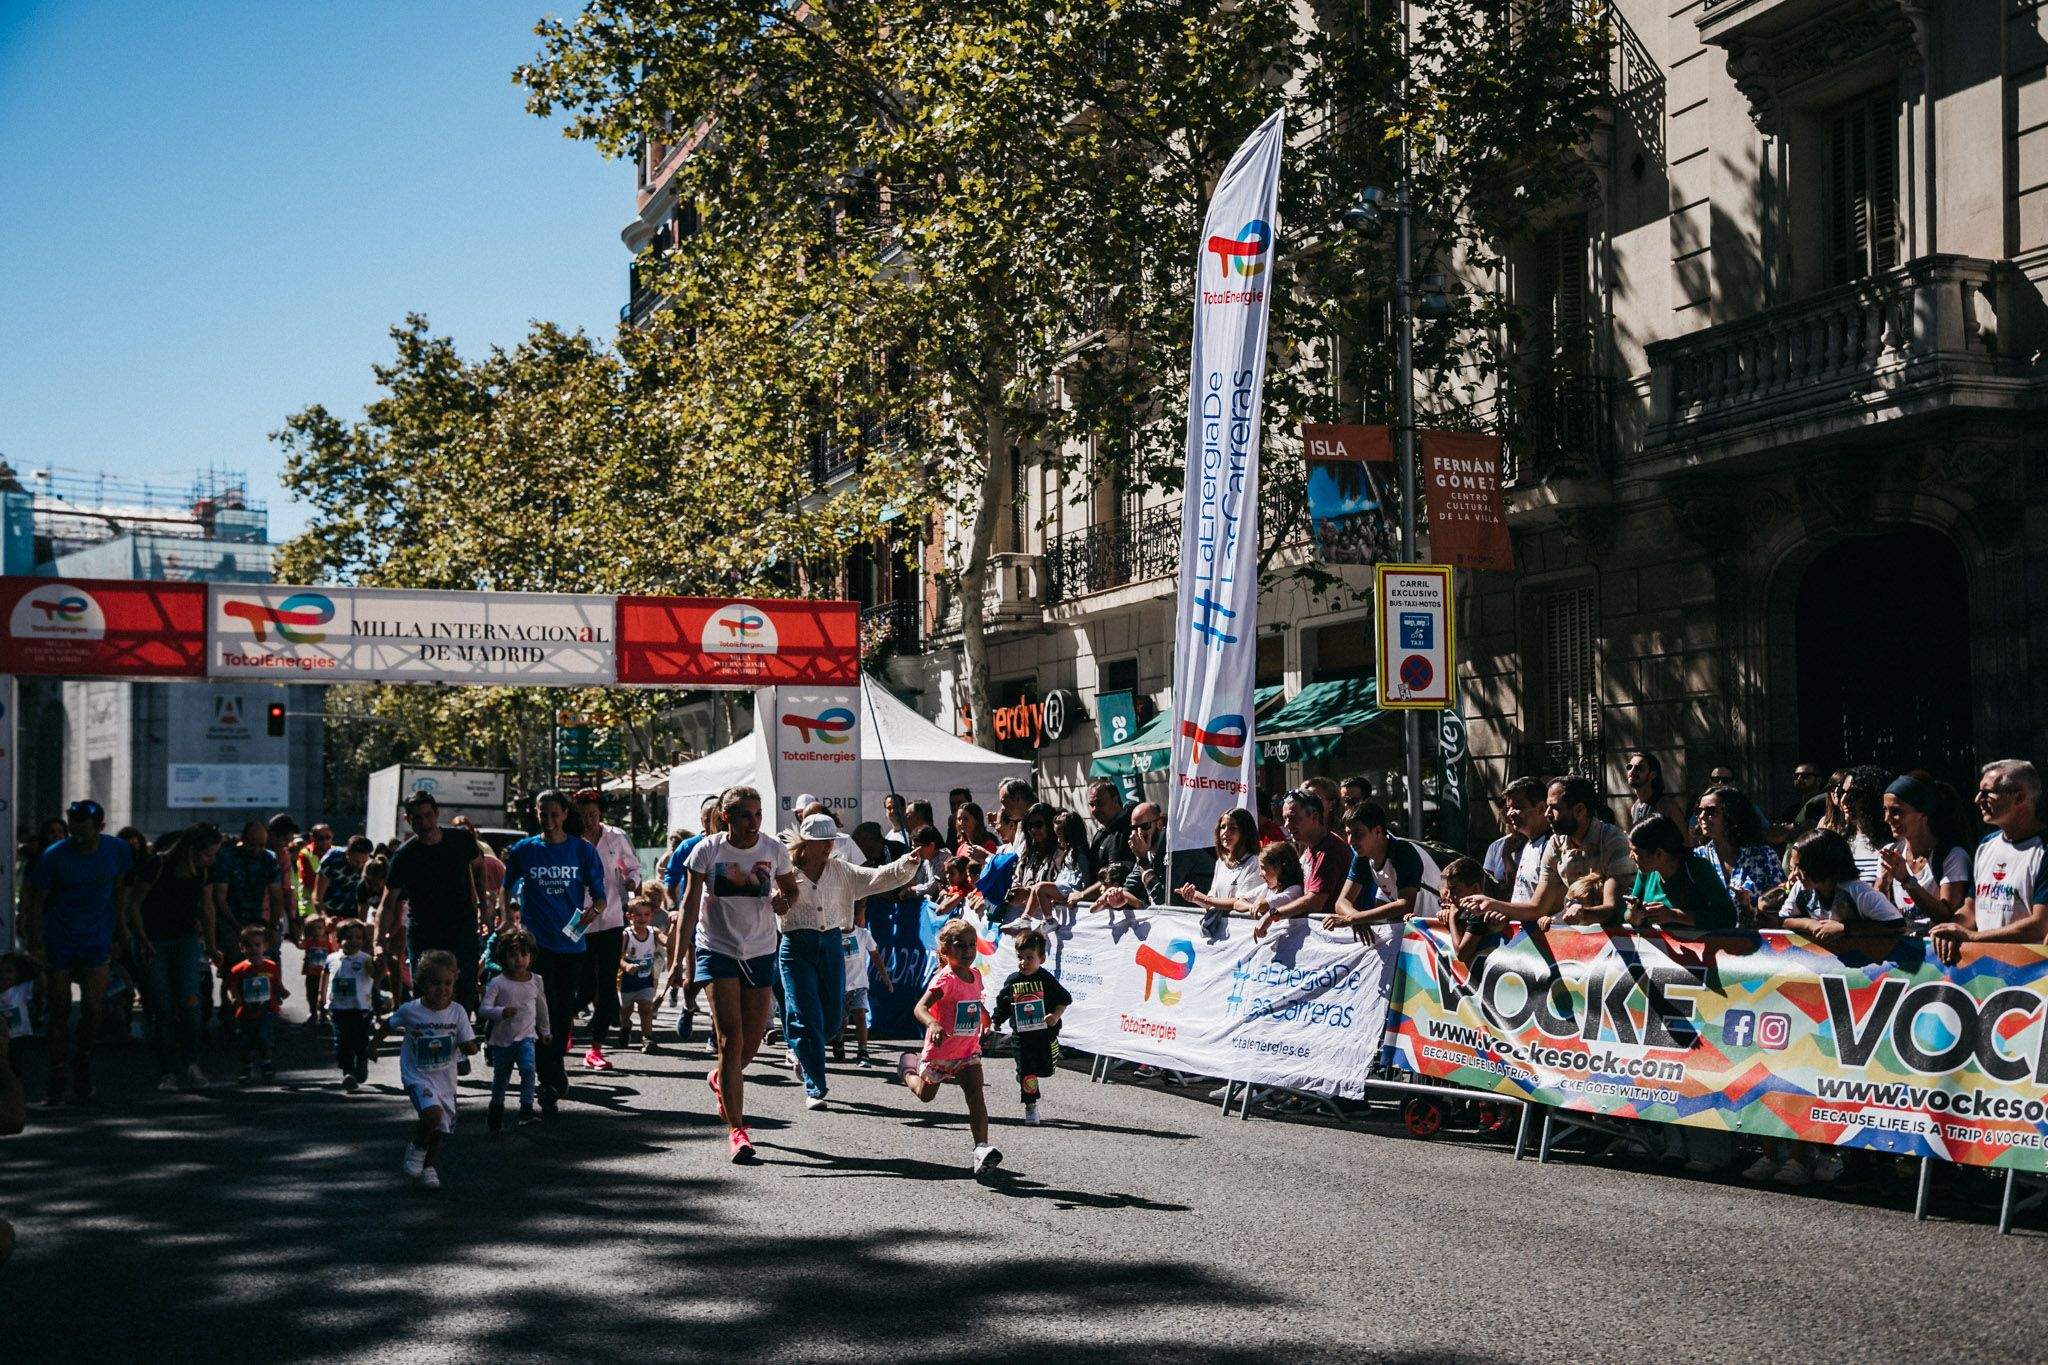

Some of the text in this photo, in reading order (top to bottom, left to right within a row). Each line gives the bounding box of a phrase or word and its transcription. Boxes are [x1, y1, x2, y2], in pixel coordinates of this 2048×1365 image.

[1203, 288, 1264, 306] TotalEnergie
[1310, 440, 1348, 456] ISLA
[1433, 457, 1495, 474] FERNÁN
[1435, 472, 1495, 491] GÓMEZ
[1451, 492, 1488, 502] CENTRO
[1446, 502, 1492, 513] CULTURAL
[1439, 512, 1499, 524] DE LA VILLA
[1399, 580, 1430, 588] CARRIL
[1391, 589, 1439, 598] EXCLUSIVO
[352, 620, 425, 638] MILLA
[223, 653, 336, 671] TotalEnergies
[419, 643, 546, 663] DE MADRID
[782, 751, 856, 763] TotalEnergies
[1263, 740, 1290, 762] Bexley
[1440, 709, 1466, 809] Bexley
[1178, 773, 1249, 795] TtalEnergies
[529, 866, 579, 879] SPORT
[1437, 946, 1709, 1051] VOCKE
[1120, 1013, 1177, 1044] TotalEnergies
[1428, 1019, 1685, 1082] www.vockesock.com
[1423, 1046, 1467, 1065] BECAUSE
[1468, 1056, 1486, 1070] LIFE
[1487, 1062, 1496, 1073] IS
[1504, 1066, 1530, 1081] TRIP
[1585, 1080, 1616, 1095] GOES
[1618, 1085, 1650, 1100] WITH
[1651, 1088, 1678, 1103] YOU
[1817, 1078, 2048, 1123] www.vockeso
[1811, 1108, 1876, 1127] BECAUSE
[1879, 1116, 1910, 1131] LIFE
[1913, 1119, 1926, 1133] IS
[1930, 1123, 1941, 1136] A
[1946, 1125, 1982, 1141] TRIP
[1985, 1131, 1992, 1143] &
[1996, 1132, 2040, 1147] VOCKE
